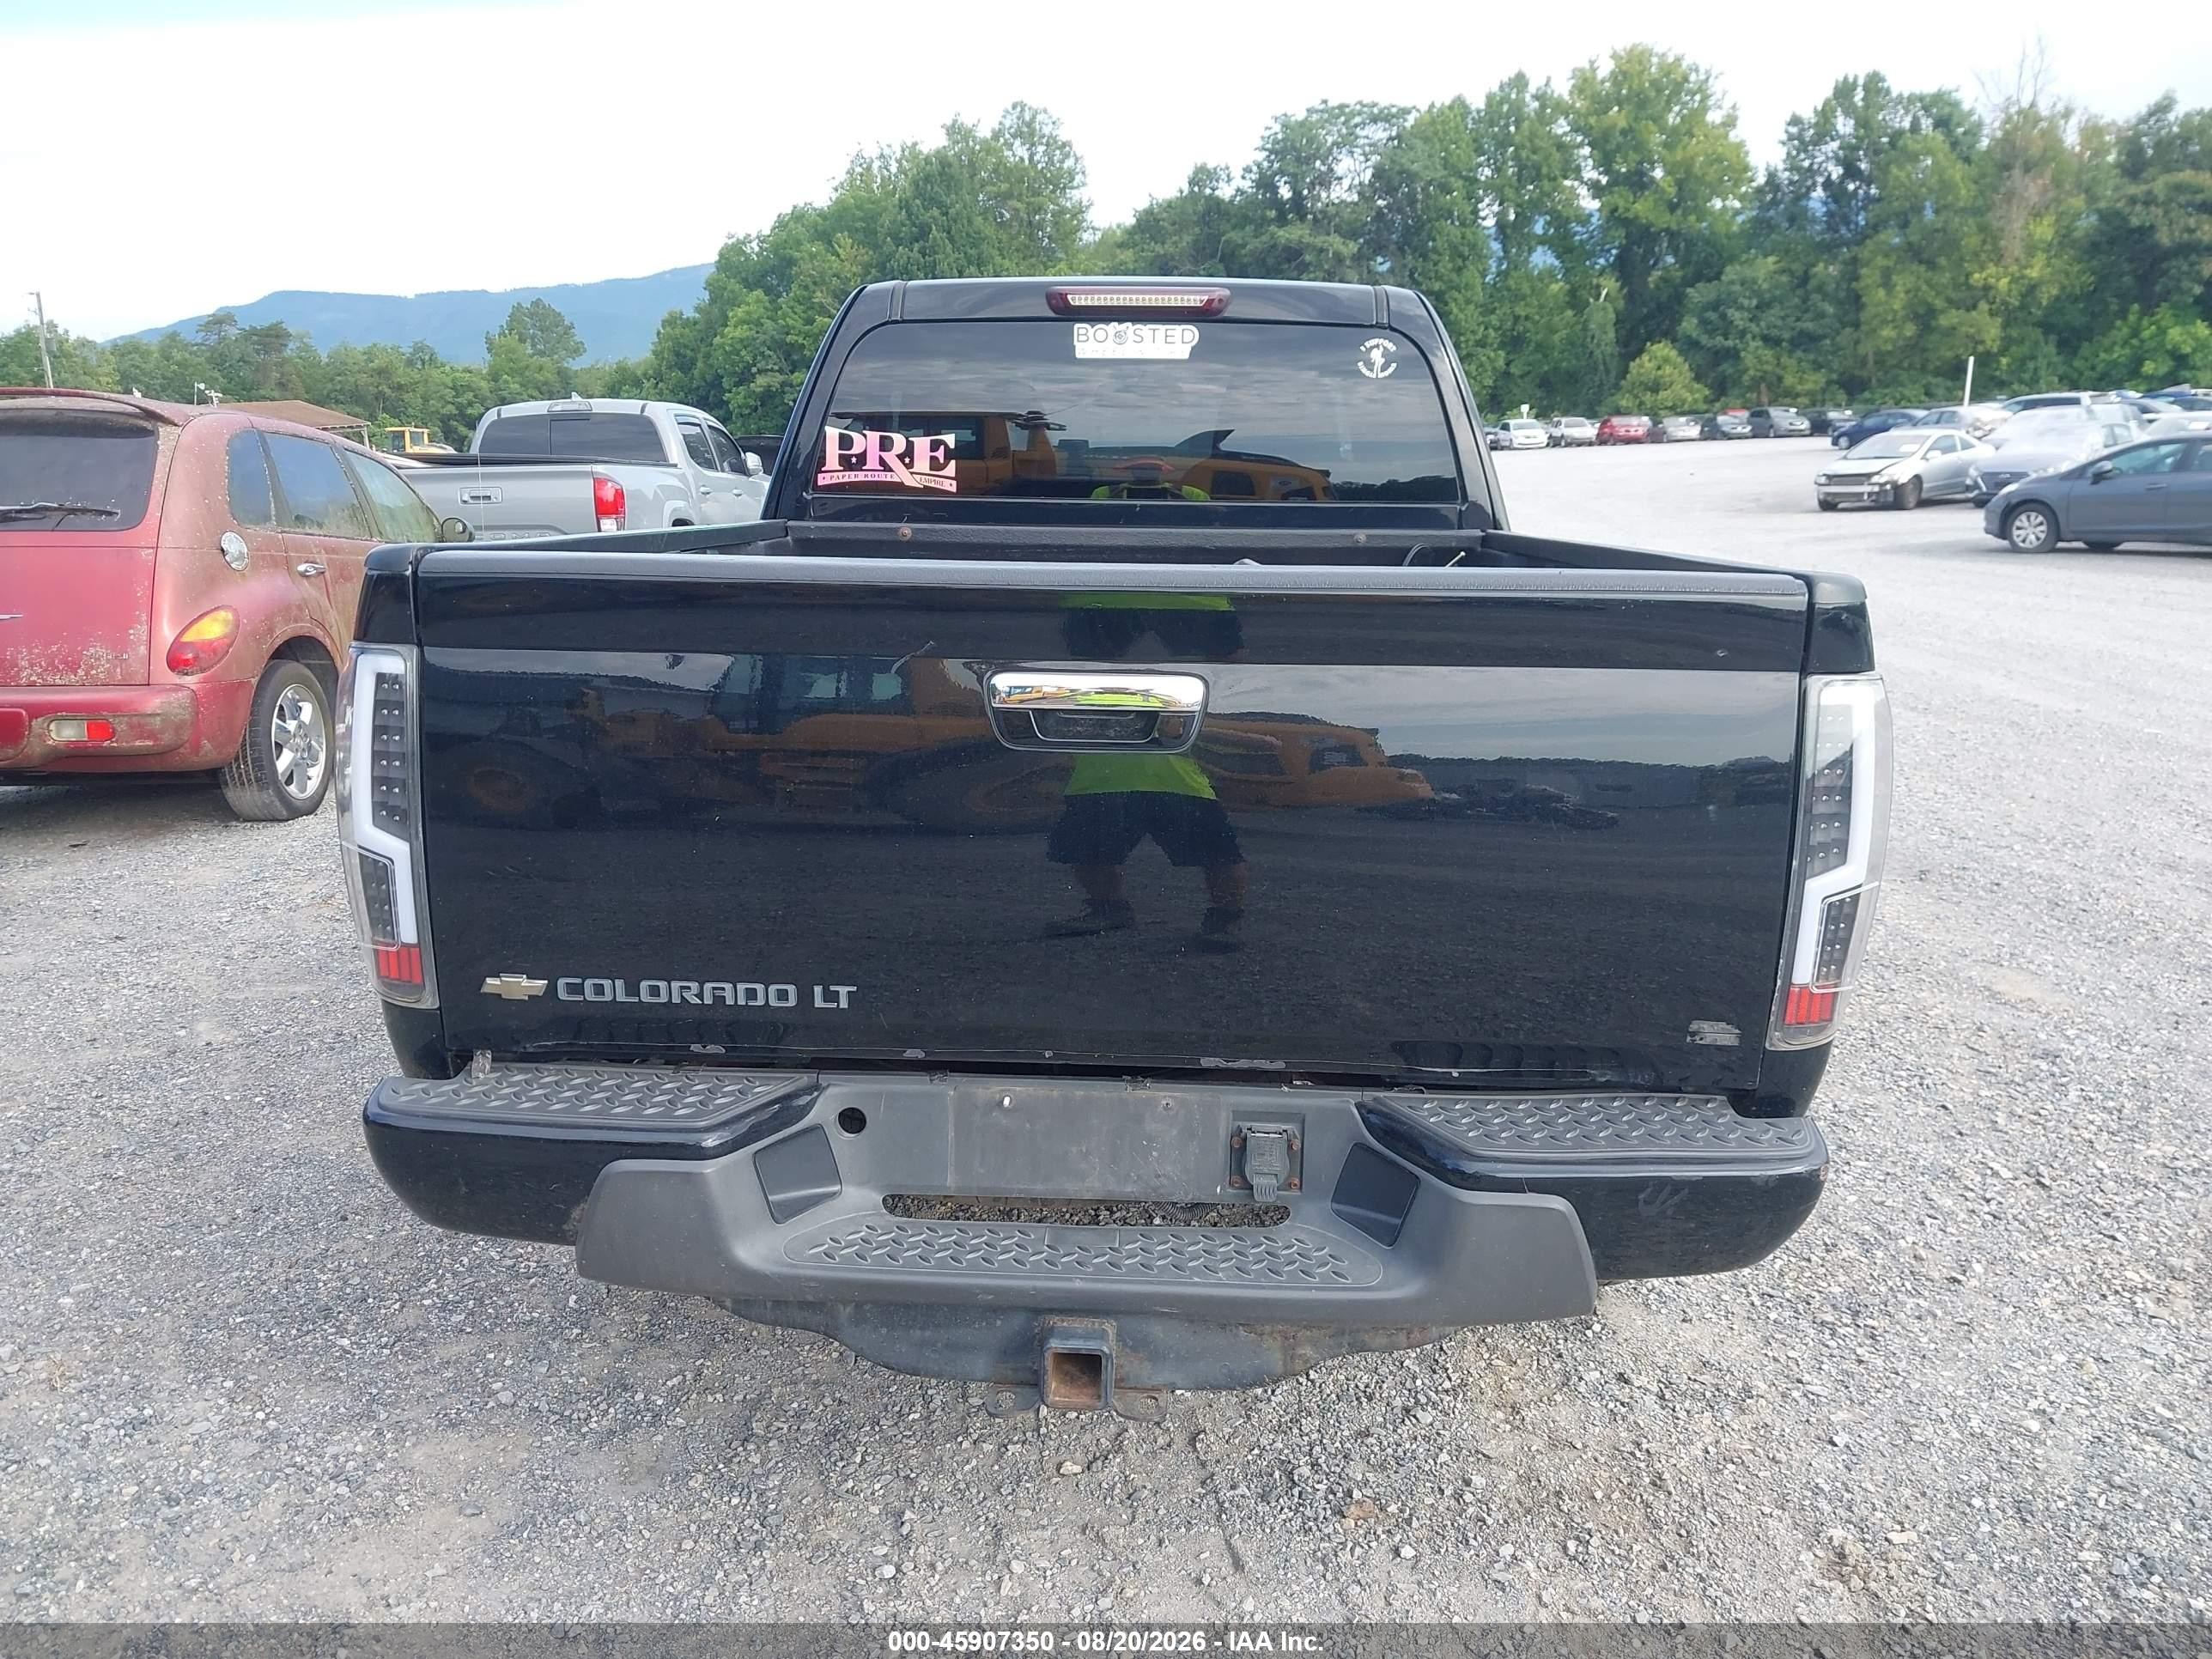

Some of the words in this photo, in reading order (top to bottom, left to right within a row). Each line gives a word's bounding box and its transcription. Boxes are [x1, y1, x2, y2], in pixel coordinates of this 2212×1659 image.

[821, 426, 956, 489] PRE
[556, 976, 798, 1007] COLORADO
[813, 985, 858, 1009] LT
